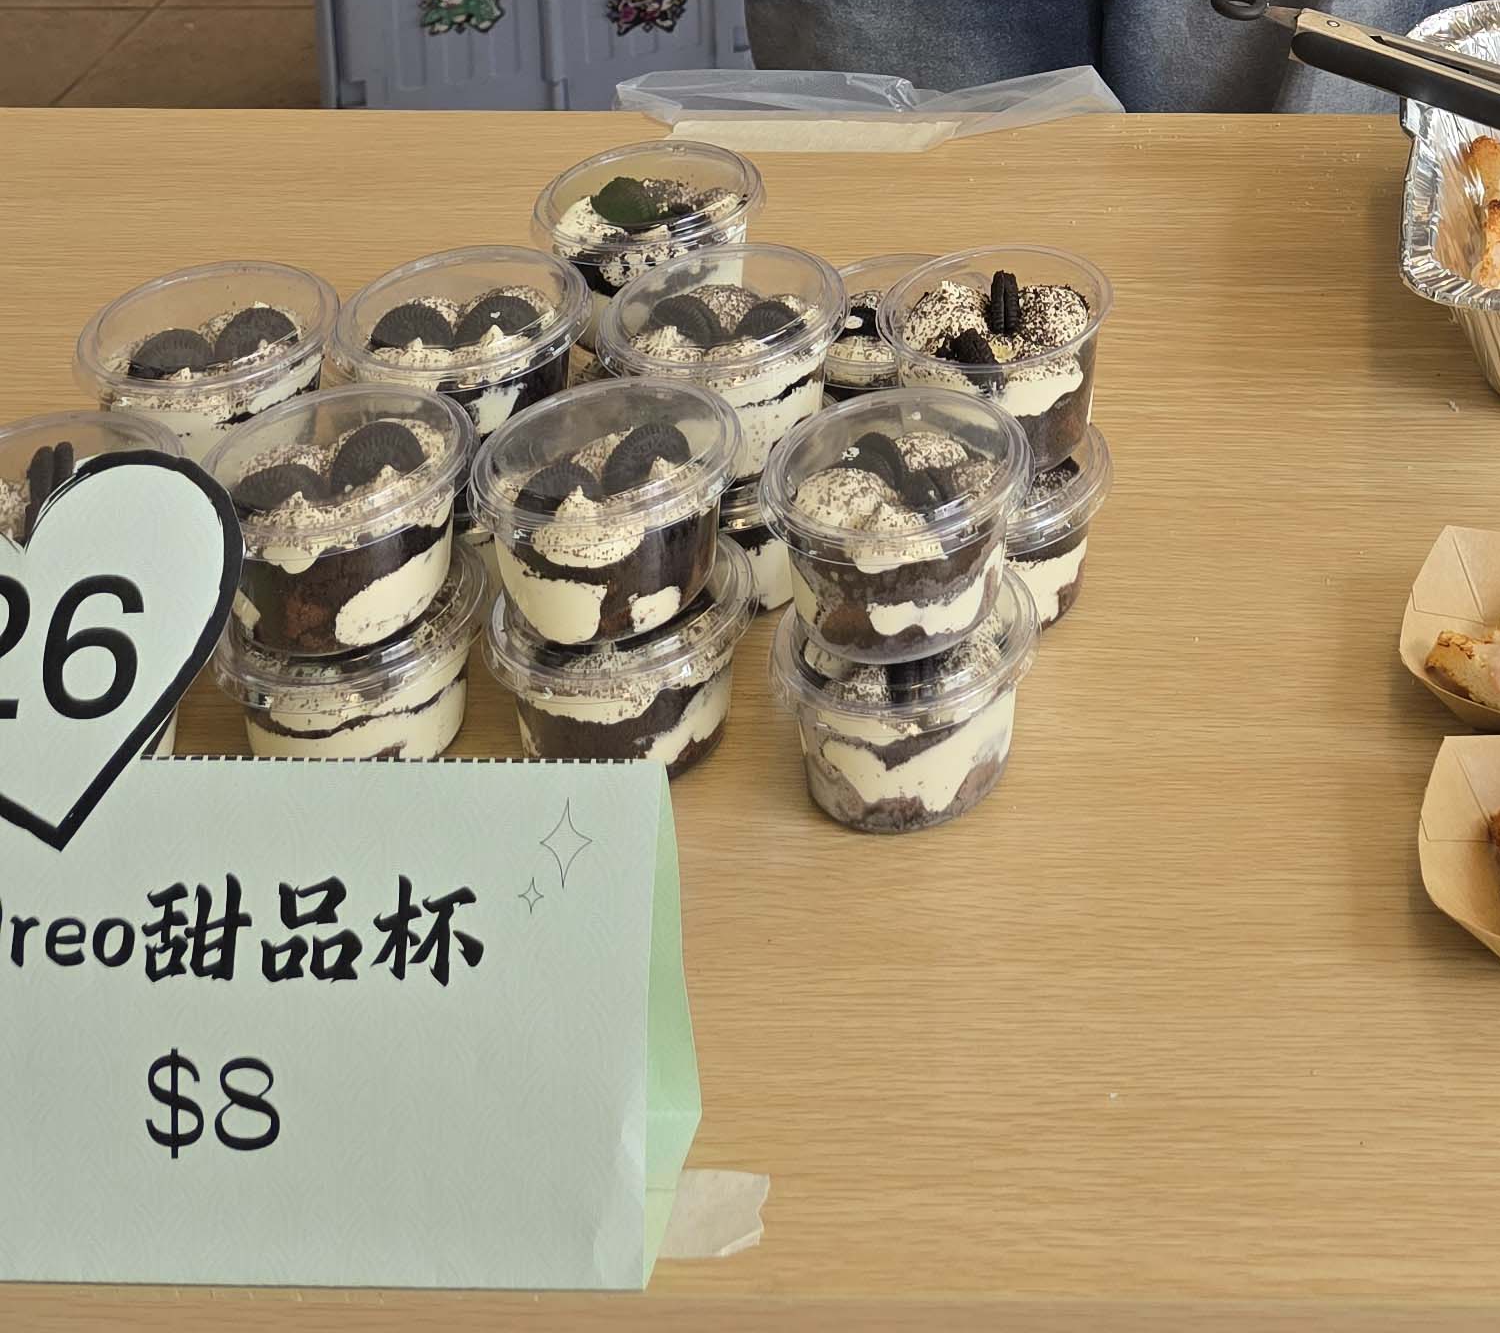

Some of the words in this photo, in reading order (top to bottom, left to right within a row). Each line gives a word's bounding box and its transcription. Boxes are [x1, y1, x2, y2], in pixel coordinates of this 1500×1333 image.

[0, 873, 486, 986] reo甜品杯
[145, 1047, 282, 1160] $8
